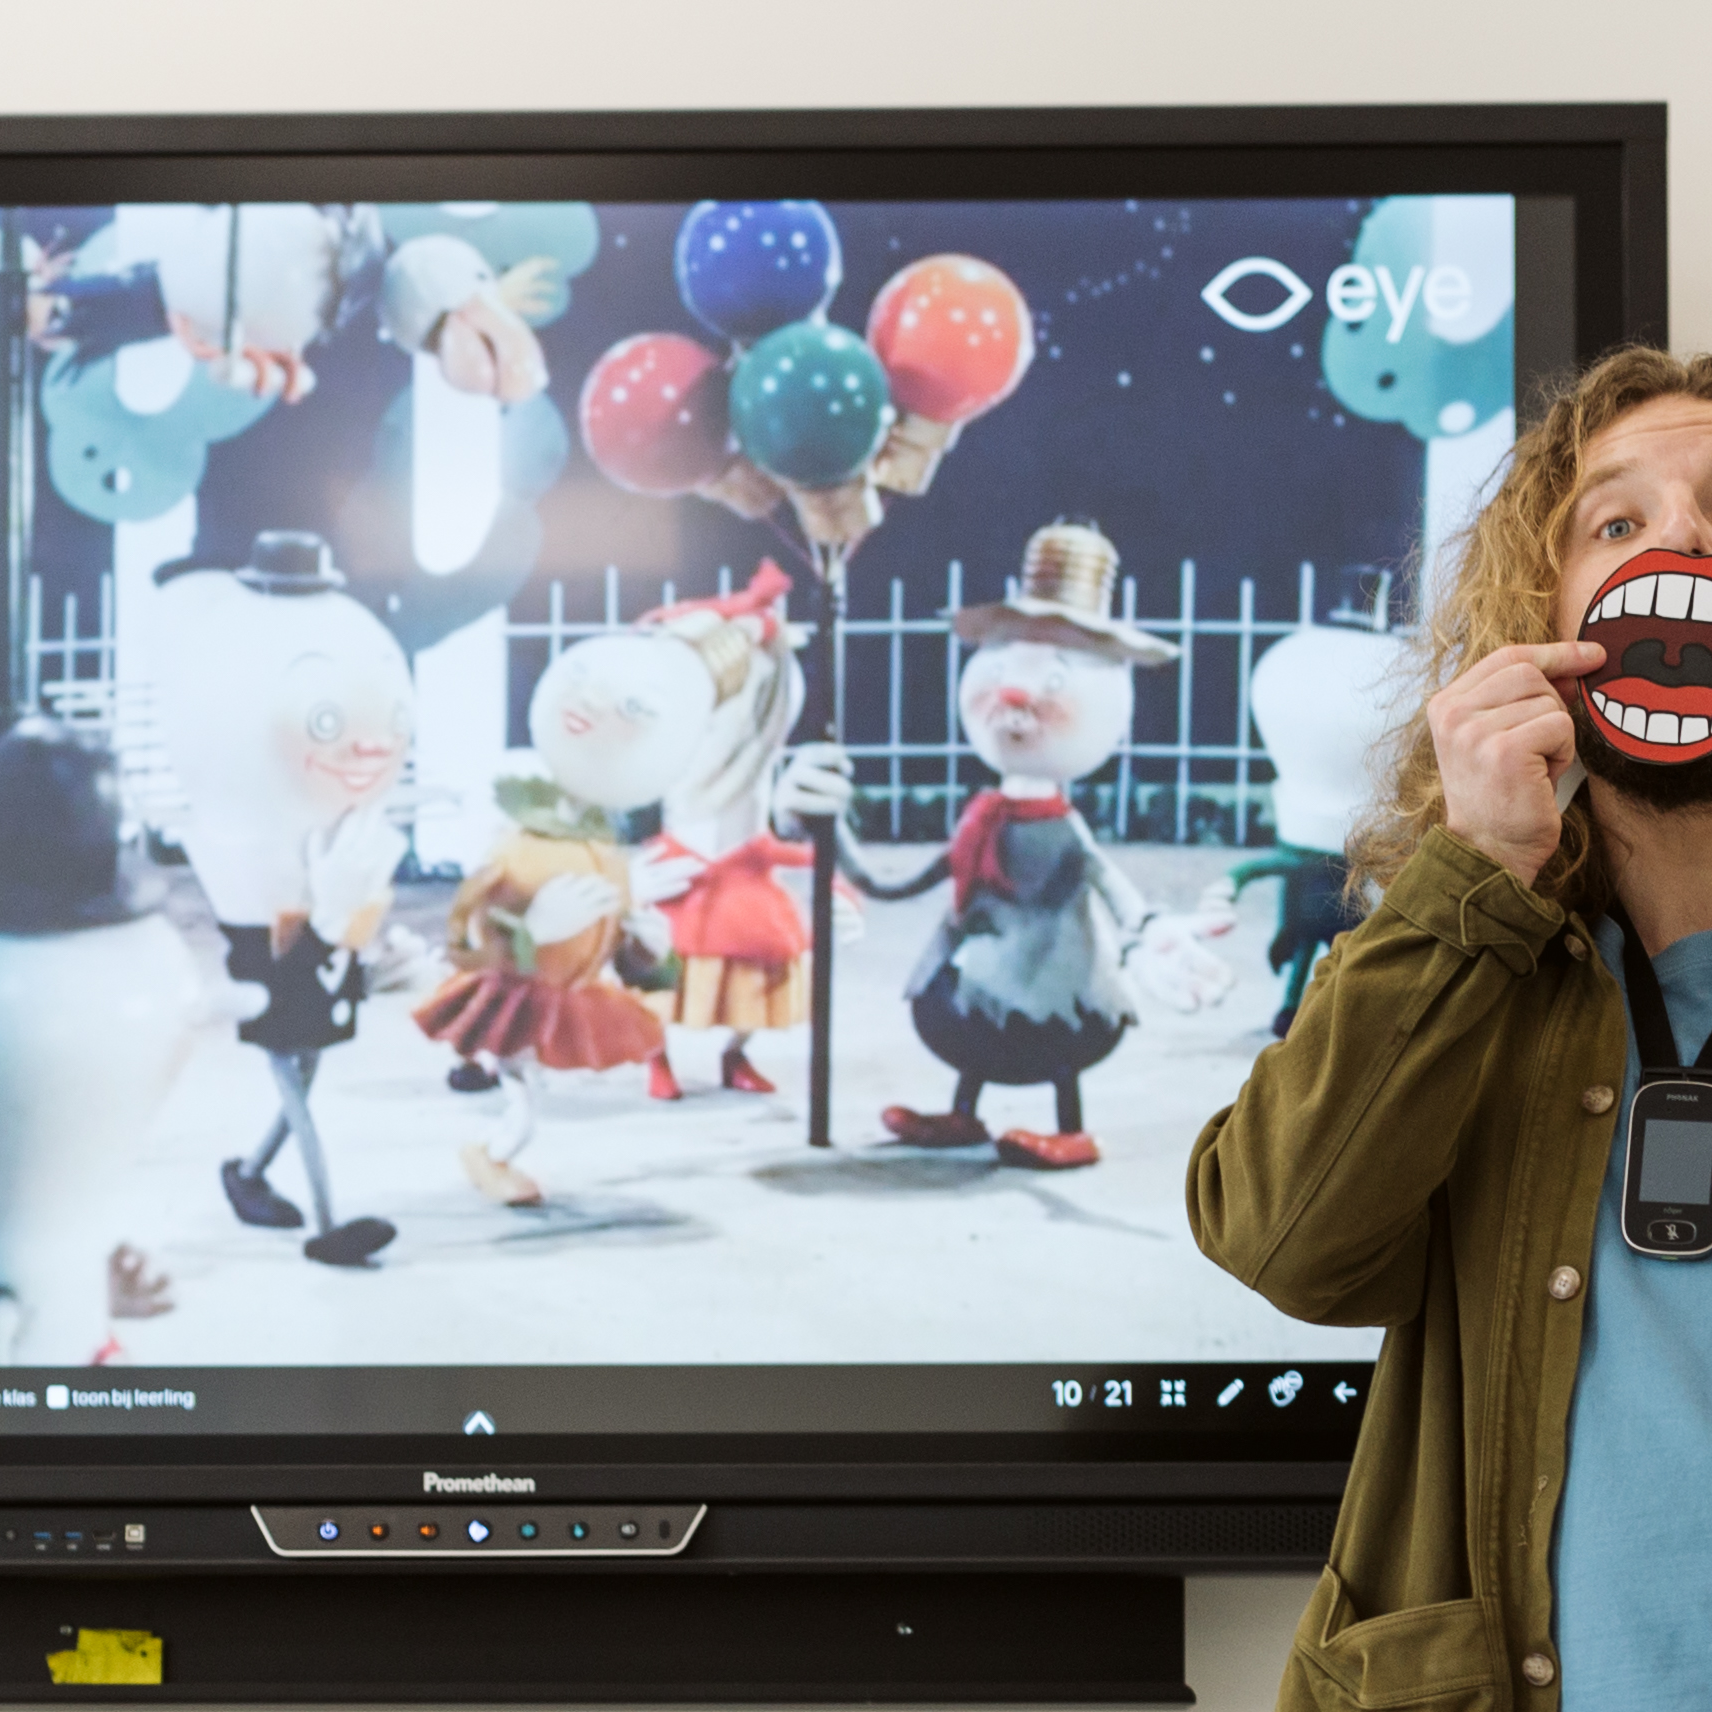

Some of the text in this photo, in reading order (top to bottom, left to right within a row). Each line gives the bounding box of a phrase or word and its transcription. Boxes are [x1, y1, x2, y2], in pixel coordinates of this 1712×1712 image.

[1326, 264, 1474, 343] eye
[2, 1389, 36, 1408] klas
[72, 1389, 196, 1411] toon bij leerling
[1051, 1379, 1083, 1407] 10
[1103, 1379, 1133, 1407] 21
[423, 1471, 536, 1493] Promethean
